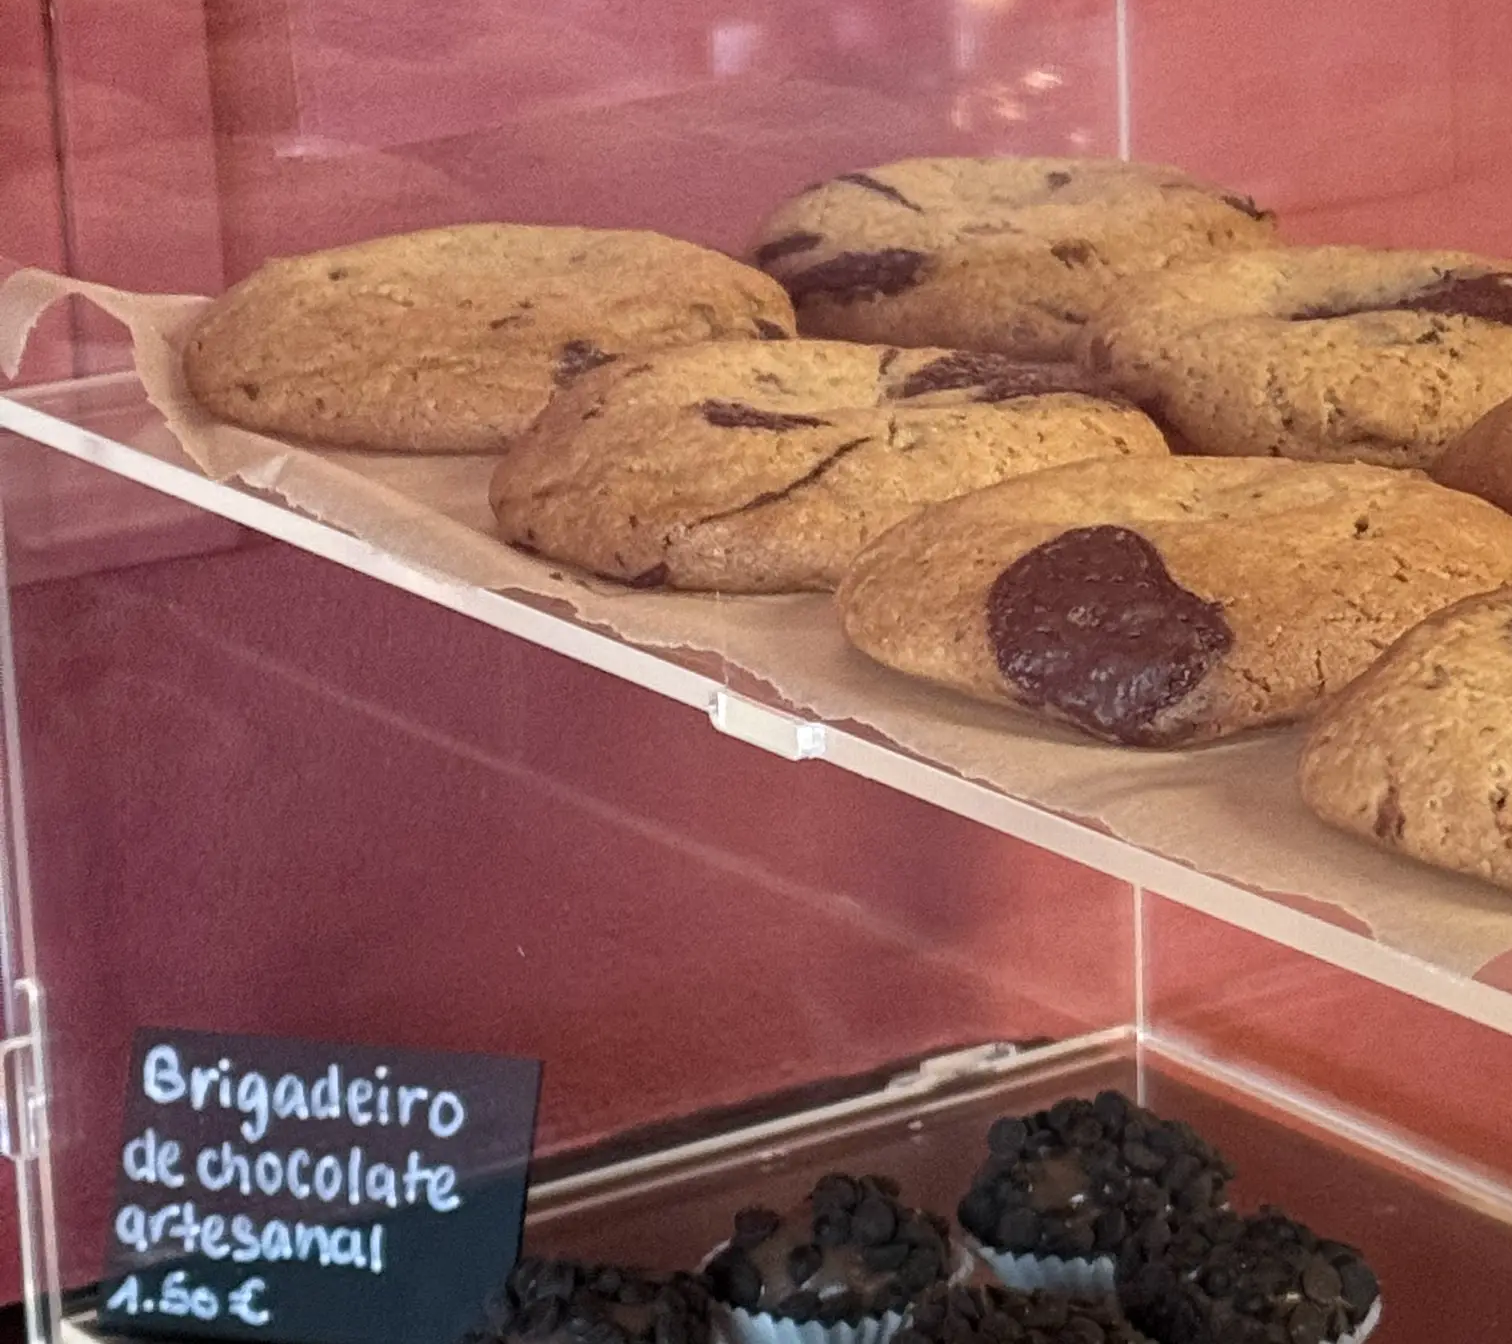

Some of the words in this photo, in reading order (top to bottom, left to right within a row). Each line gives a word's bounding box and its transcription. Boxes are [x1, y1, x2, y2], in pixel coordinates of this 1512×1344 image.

[143, 1044, 465, 1143] Brigadeiro
[122, 1127, 185, 1188] de
[196, 1141, 461, 1211] chocolate
[115, 1201, 384, 1274] artesanal
